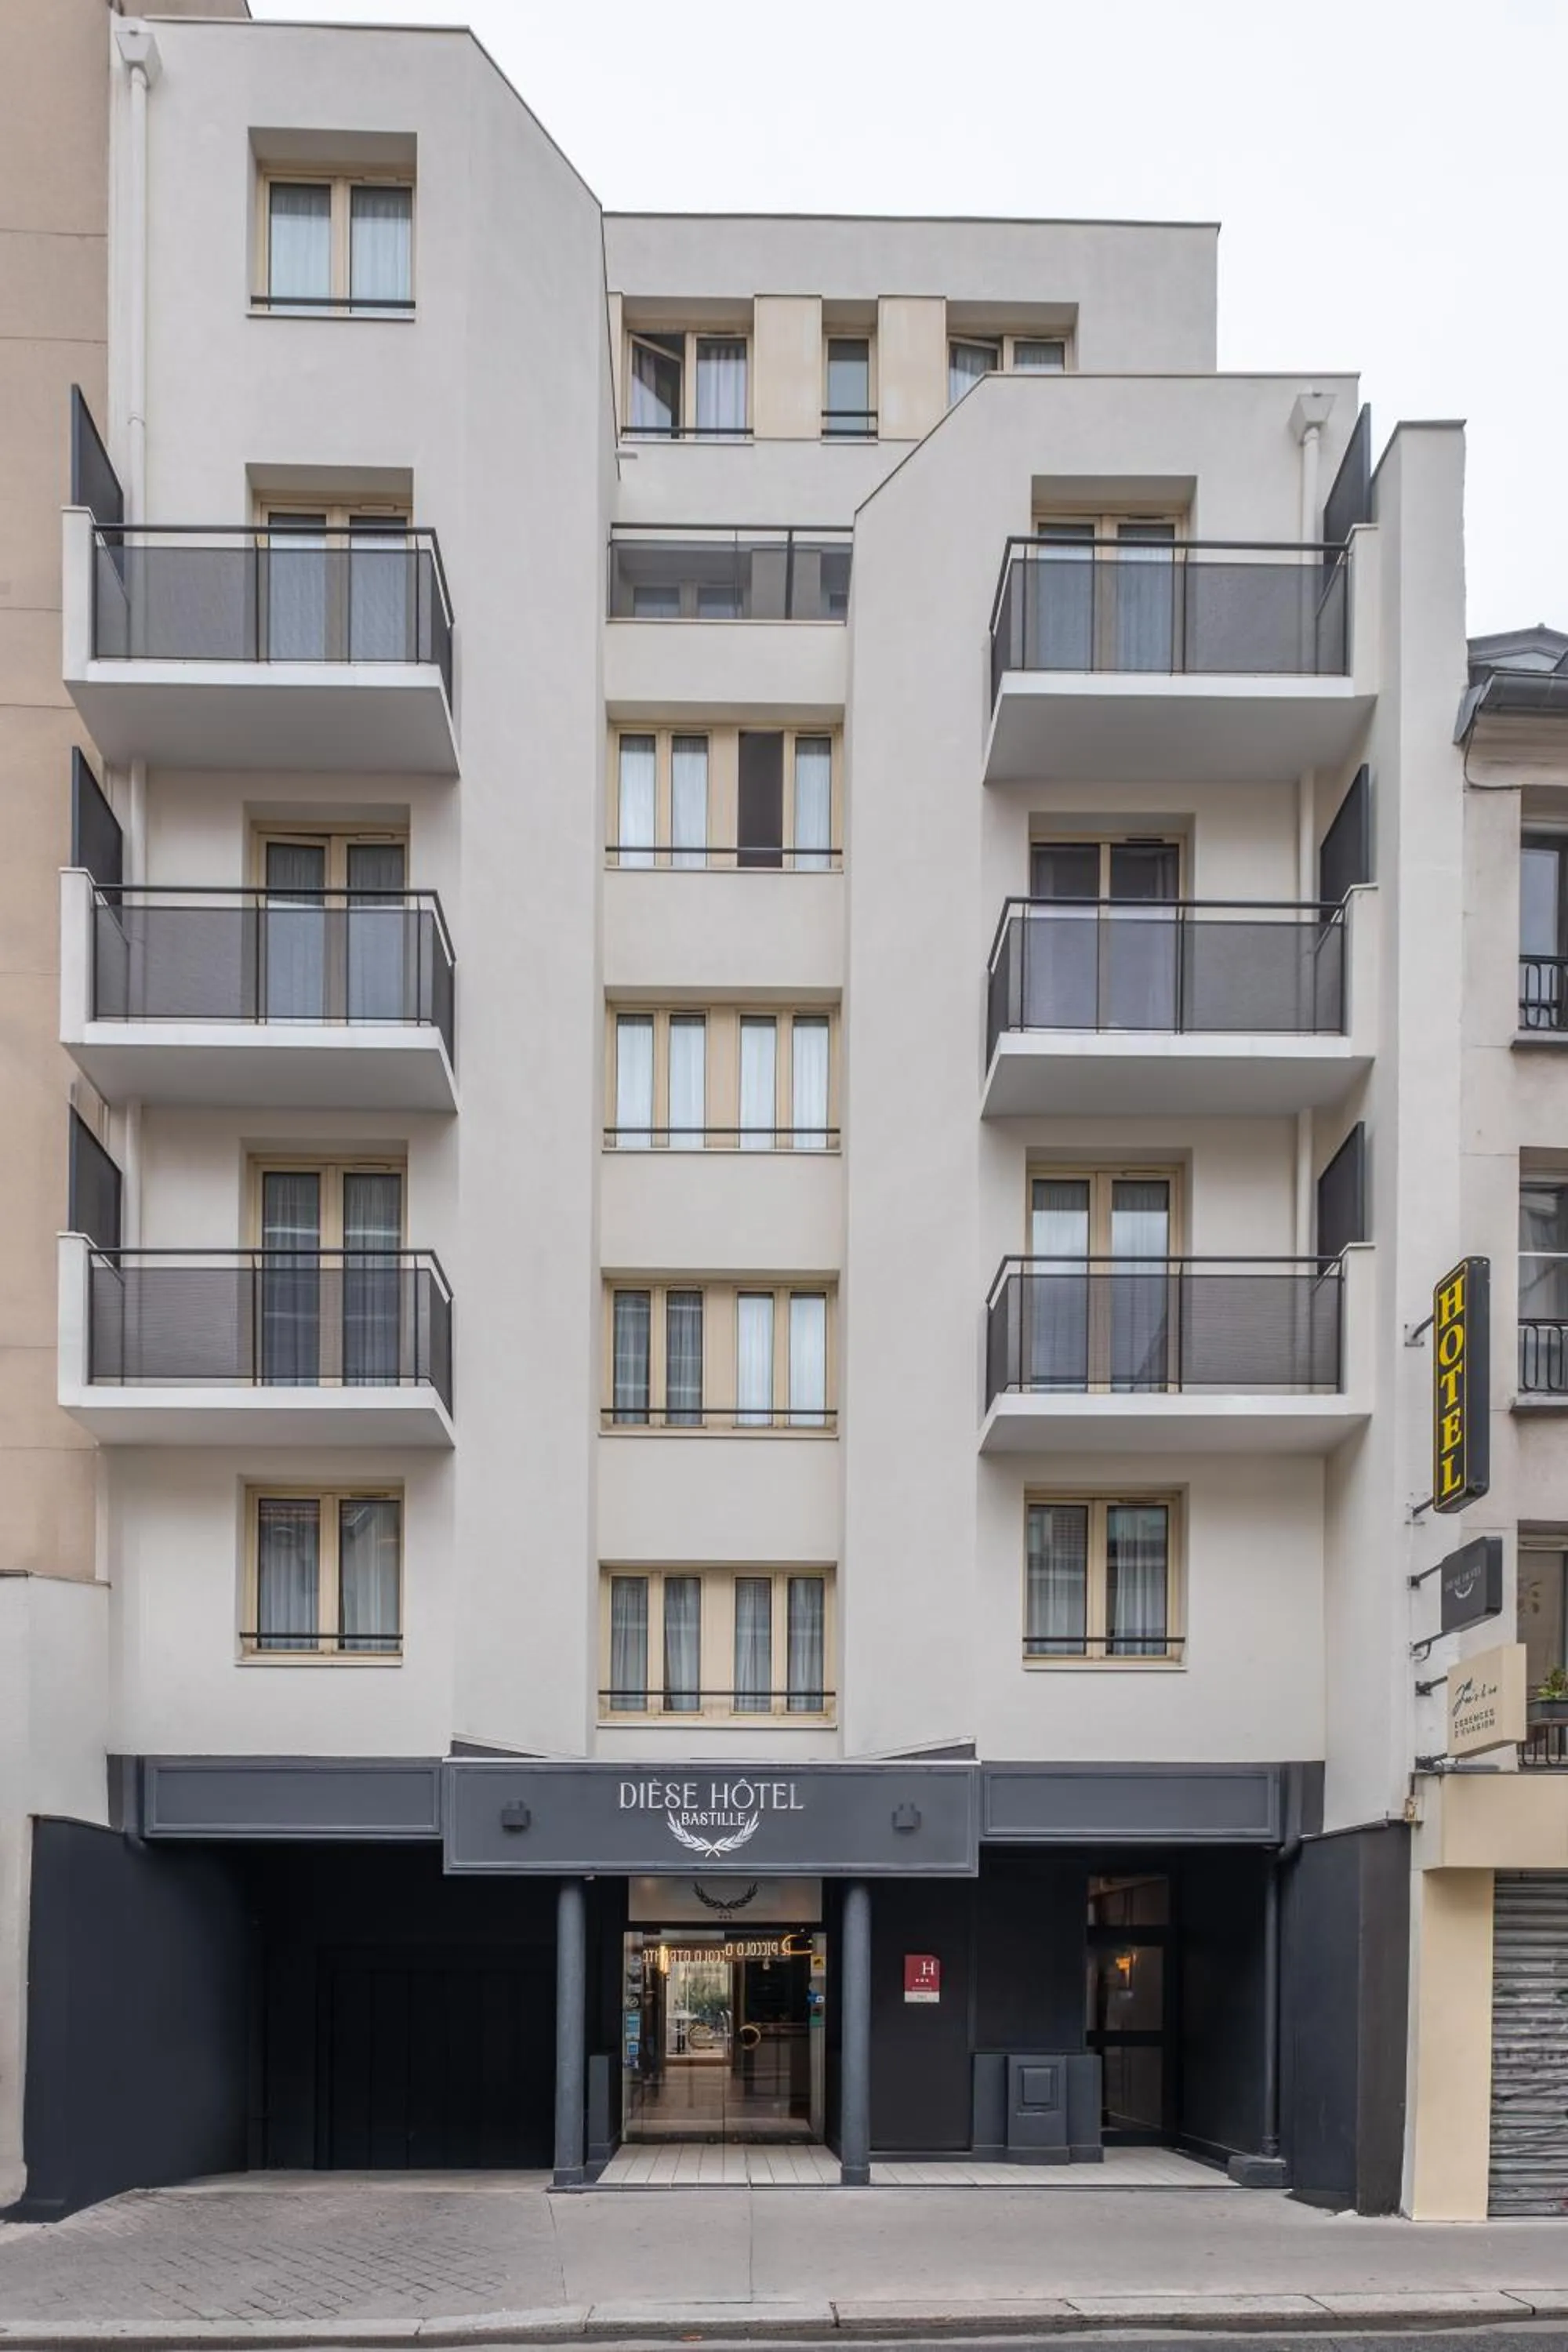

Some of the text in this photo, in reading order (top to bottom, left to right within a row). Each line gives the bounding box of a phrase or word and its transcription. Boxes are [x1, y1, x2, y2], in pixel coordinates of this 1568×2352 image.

[1439, 1273, 1465, 1497] HOTEL
[619, 1777, 804, 1809] DIÈSE HÔTEL
[681, 1812, 746, 1825] BASTILLE
[922, 1961, 935, 1975] H
